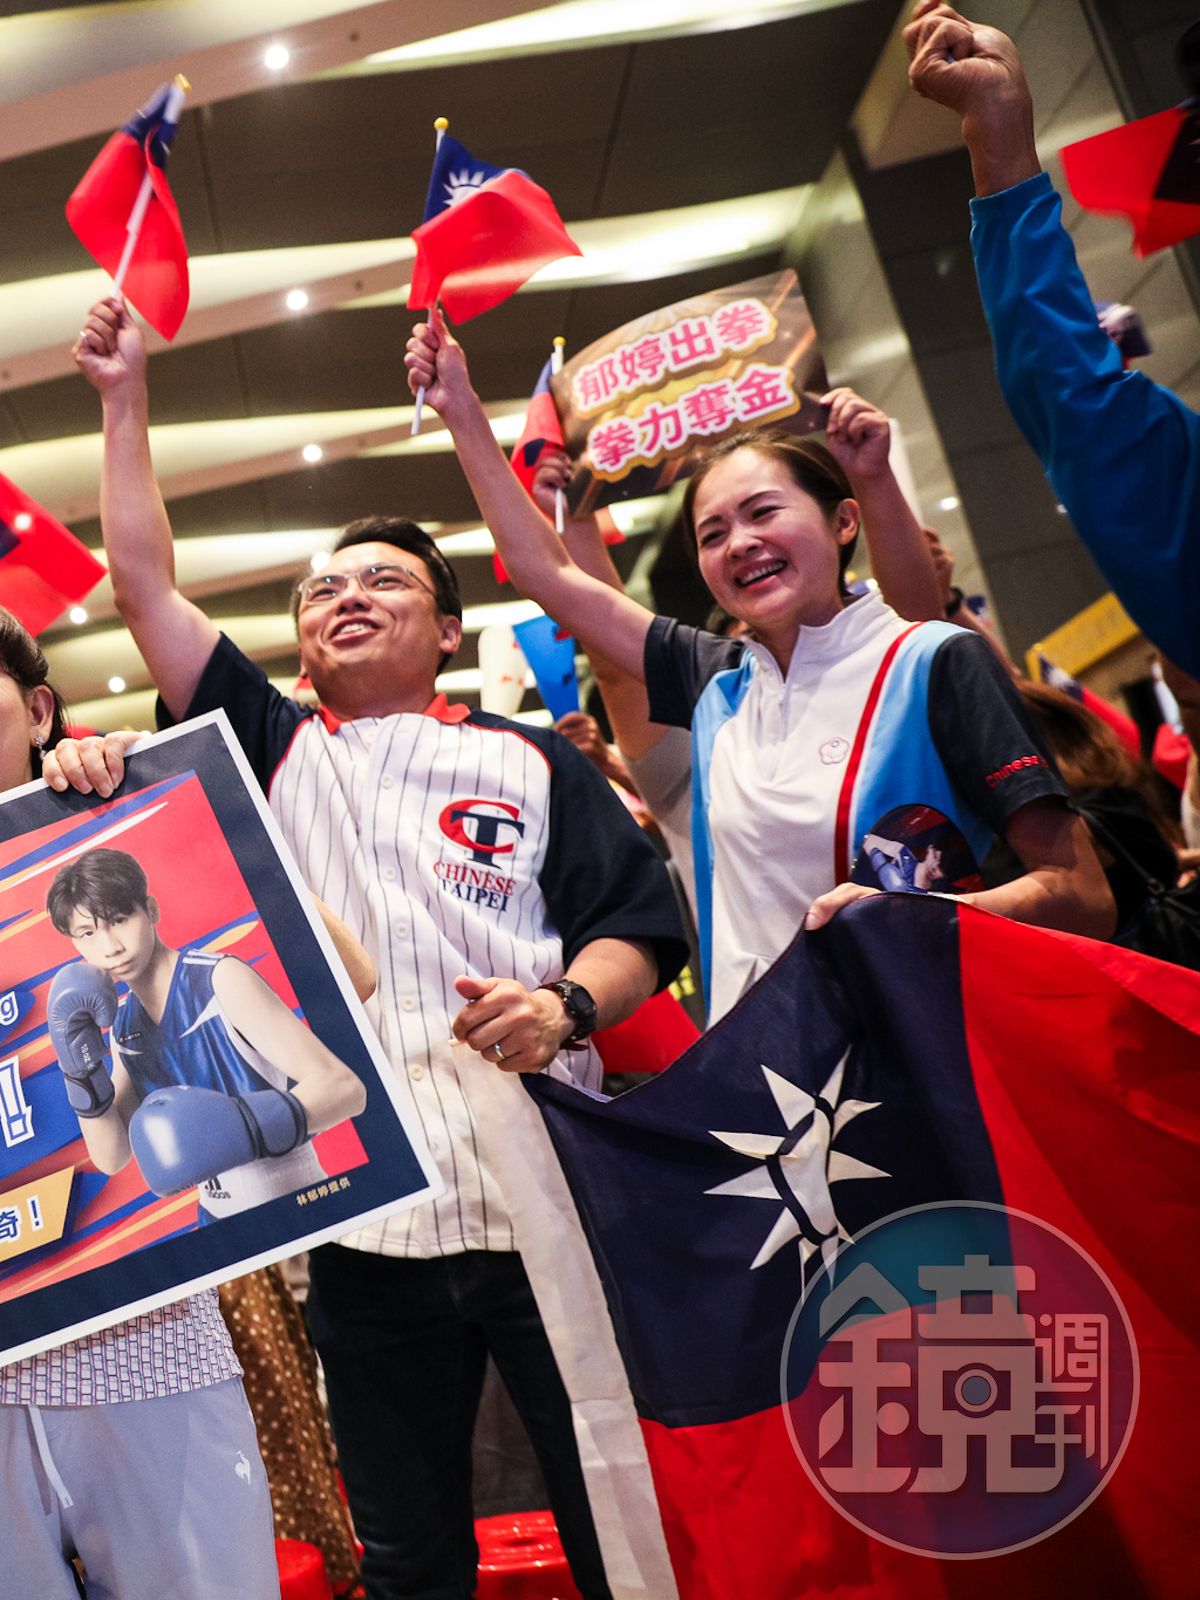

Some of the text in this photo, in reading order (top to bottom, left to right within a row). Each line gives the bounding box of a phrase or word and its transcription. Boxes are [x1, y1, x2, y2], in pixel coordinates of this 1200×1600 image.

[577, 302, 764, 406] 郁婷出拳
[592, 368, 788, 468] 拳力奪金
[433, 860, 517, 897] CHINESE
[441, 879, 510, 912] TAIPEI
